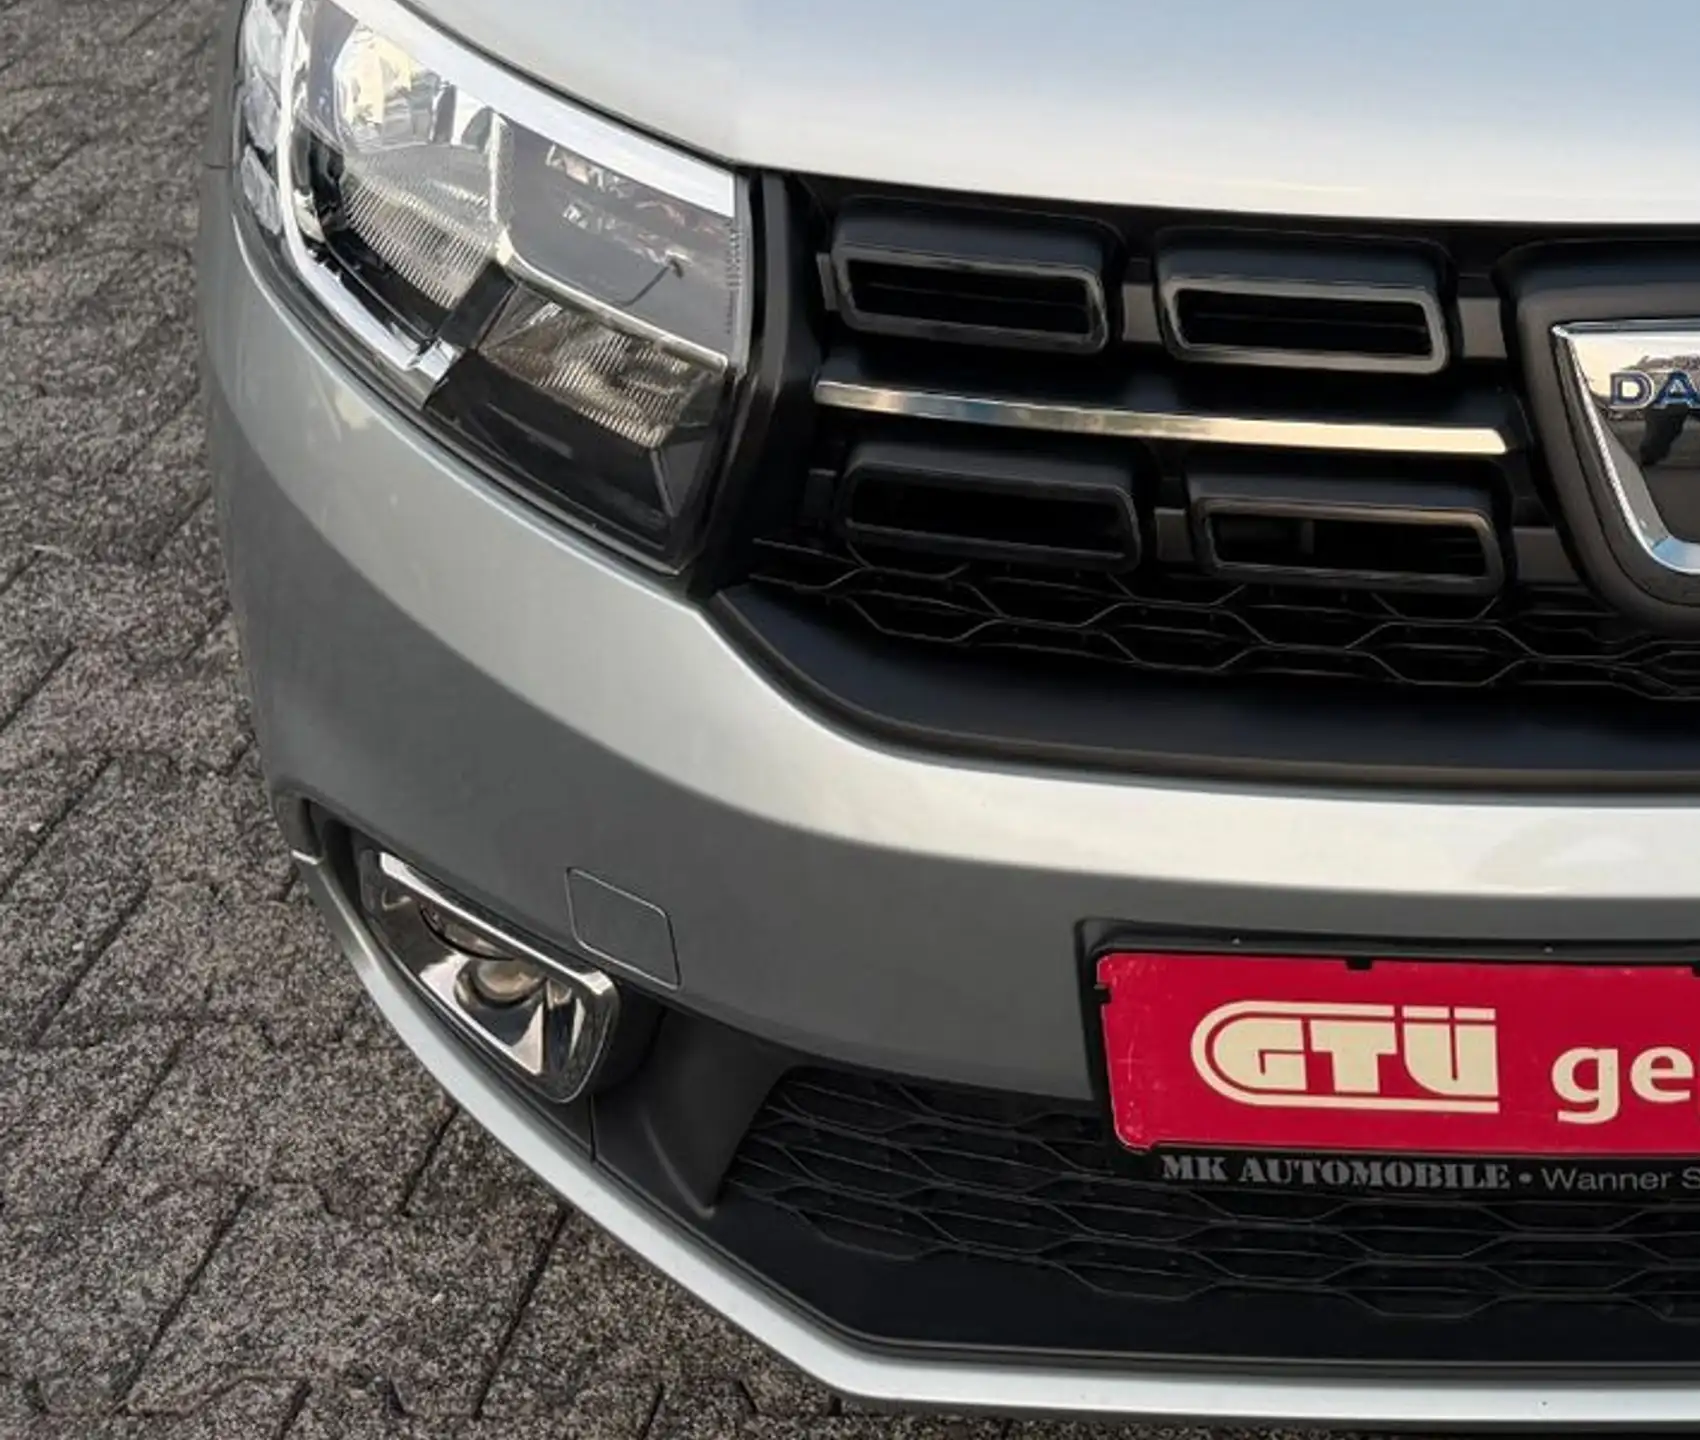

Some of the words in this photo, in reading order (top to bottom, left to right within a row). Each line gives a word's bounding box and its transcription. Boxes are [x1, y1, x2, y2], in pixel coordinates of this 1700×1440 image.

[1211, 1004, 1499, 1097] GTÜ
[1160, 1154, 1229, 1181] MK
[1239, 1158, 1512, 1190] AUTOMOBILE
[1540, 1166, 1673, 1191] Wanner
